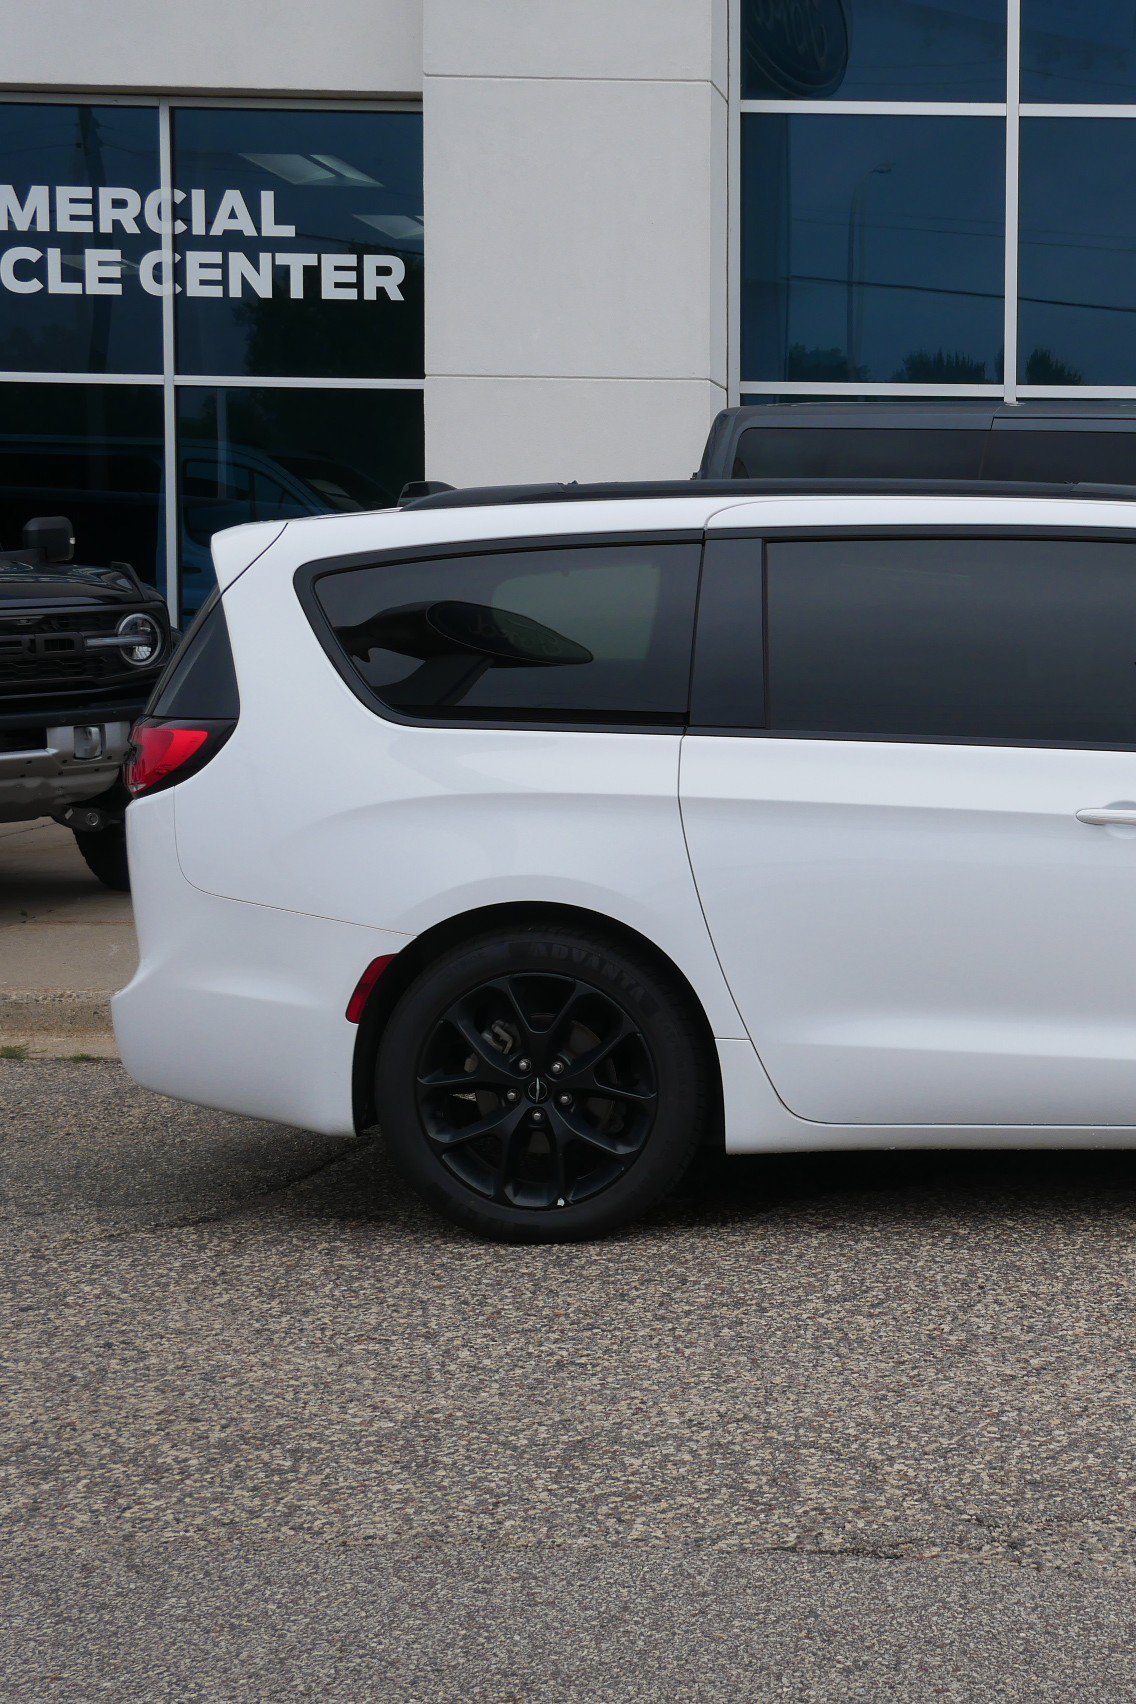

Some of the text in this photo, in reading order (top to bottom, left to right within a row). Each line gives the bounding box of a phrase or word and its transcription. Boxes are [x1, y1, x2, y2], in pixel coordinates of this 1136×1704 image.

[0, 185, 296, 237] MERCIAL
[0, 246, 405, 300] CLE CENTER
